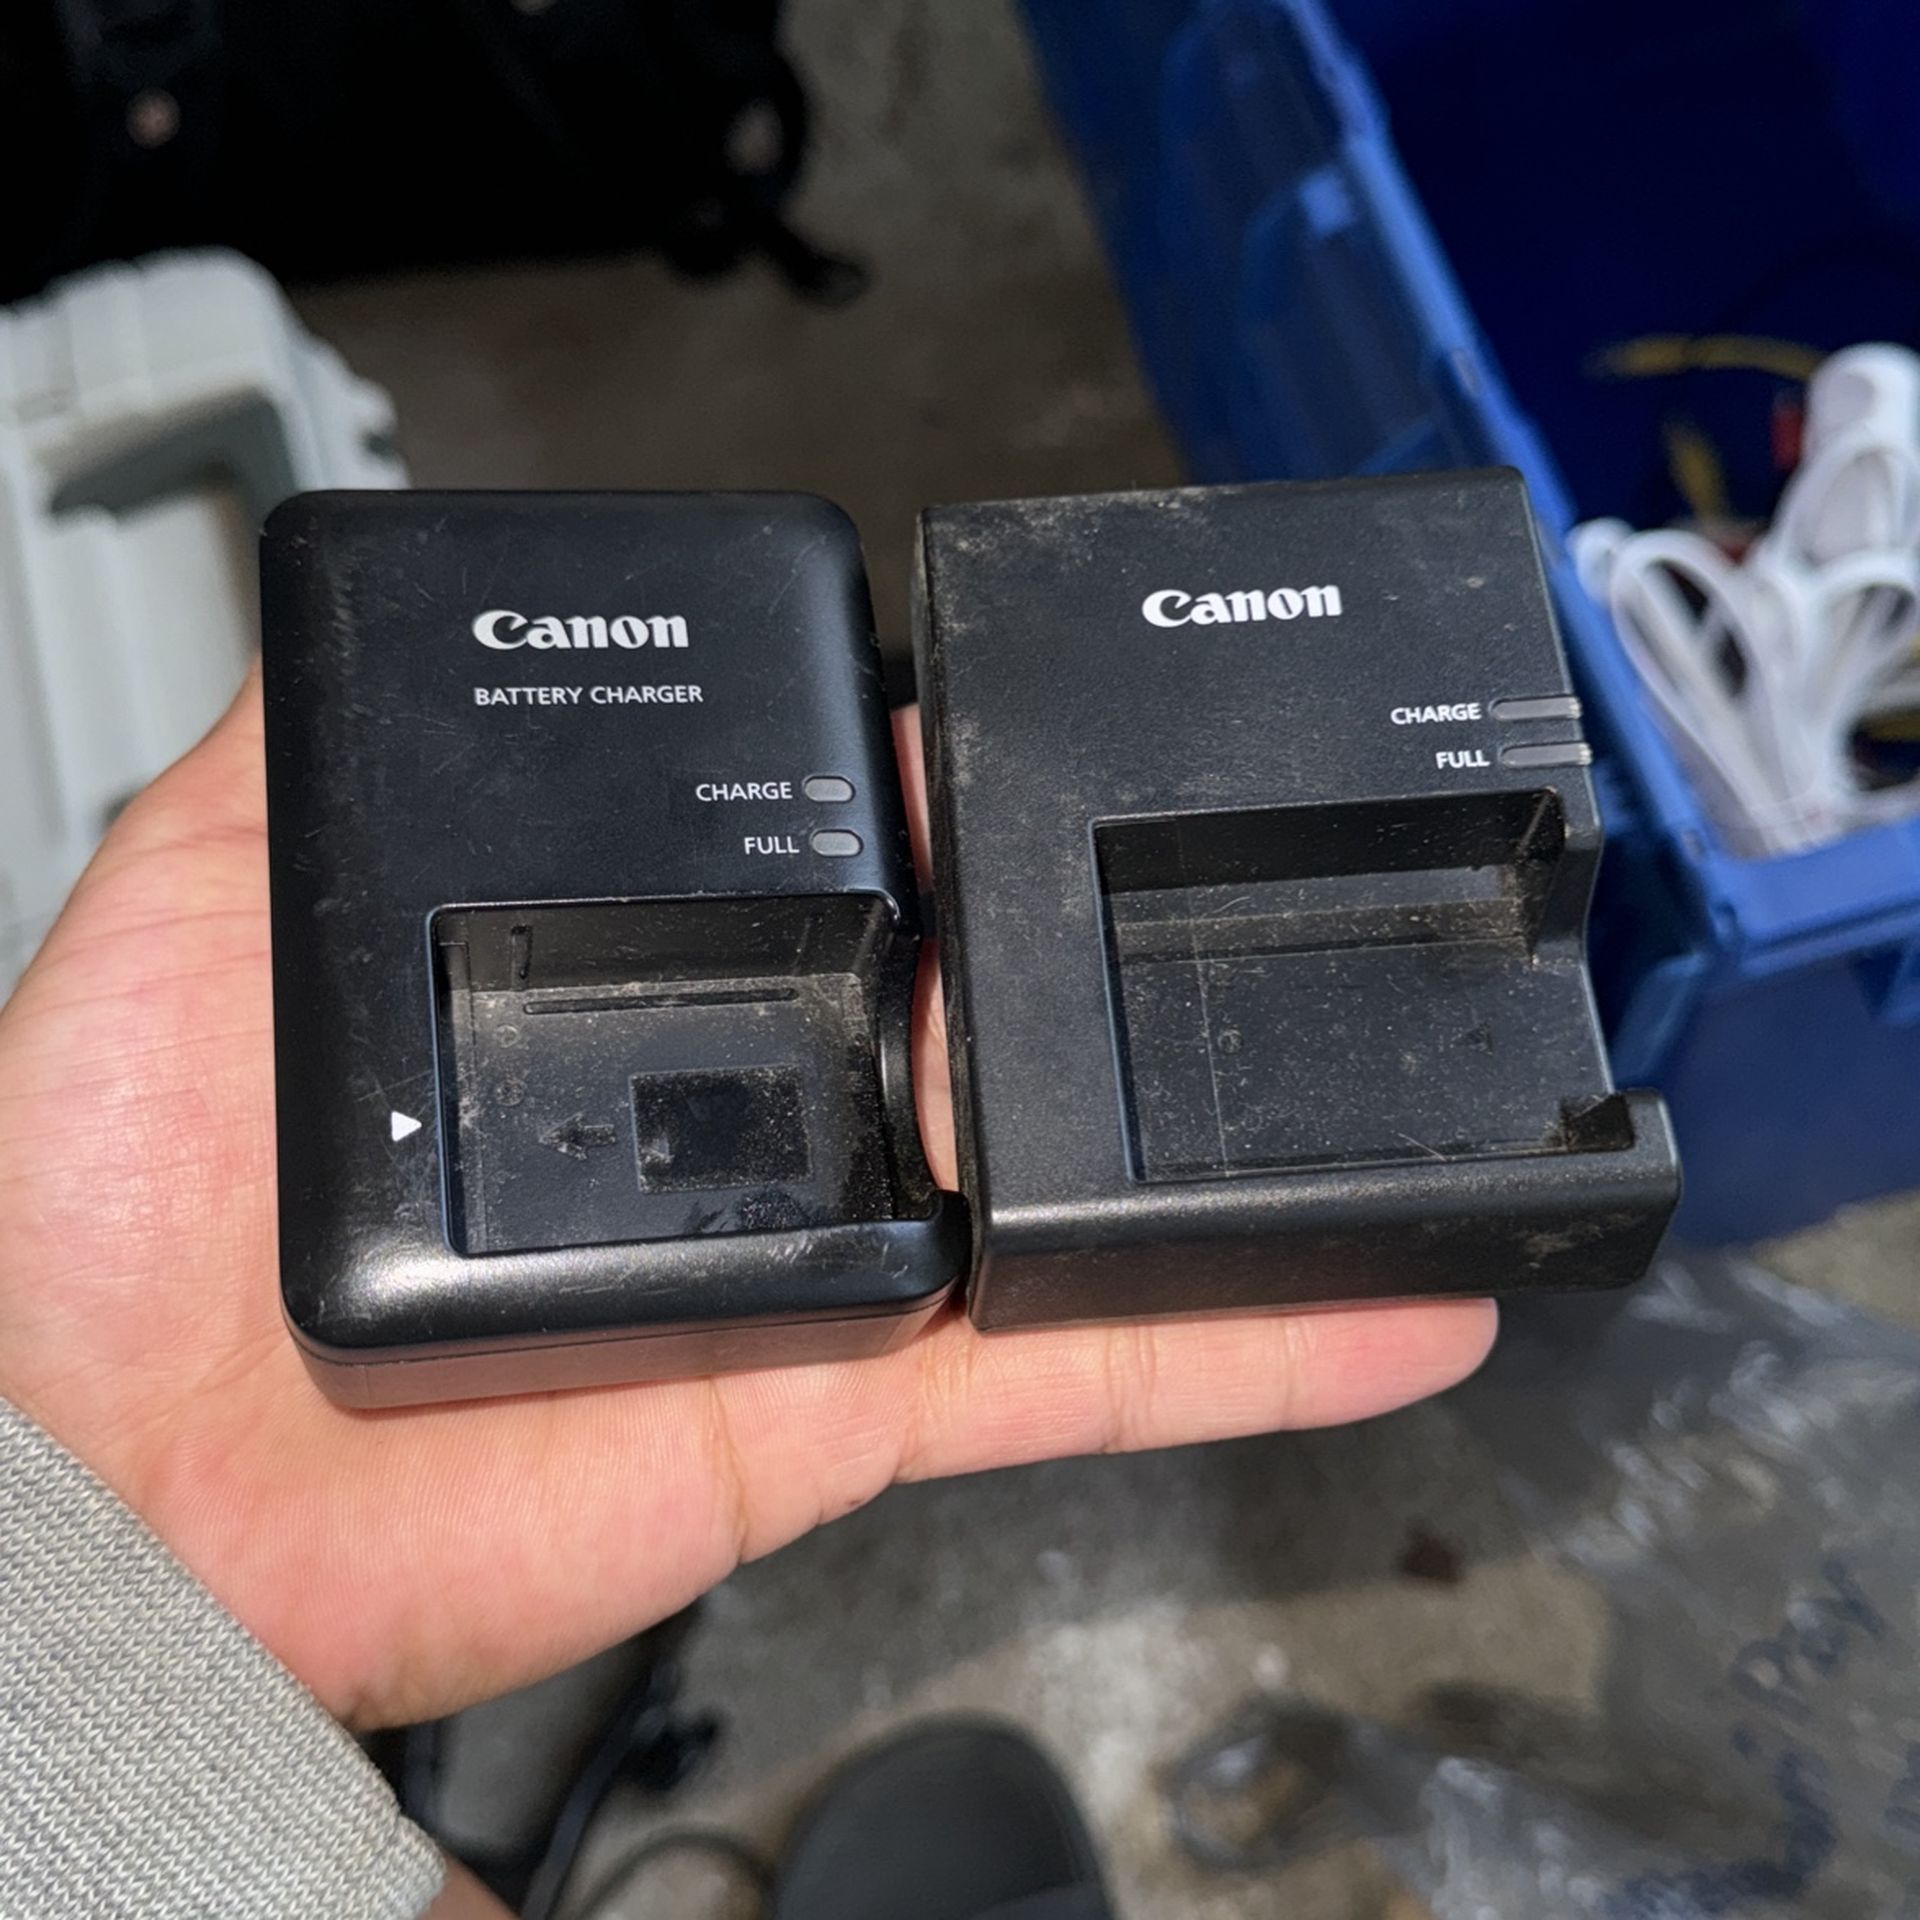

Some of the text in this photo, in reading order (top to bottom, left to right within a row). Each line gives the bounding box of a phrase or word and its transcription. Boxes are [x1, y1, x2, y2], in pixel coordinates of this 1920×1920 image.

[1141, 584, 1343, 628] Canon
[472, 609, 689, 650] Canon
[474, 684, 704, 706] BATTERY CHARGER
[1389, 701, 1483, 726] CHARGE
[1435, 748, 1491, 770] FULL
[695, 781, 793, 802] CHARGE
[743, 835, 801, 855] FULL
